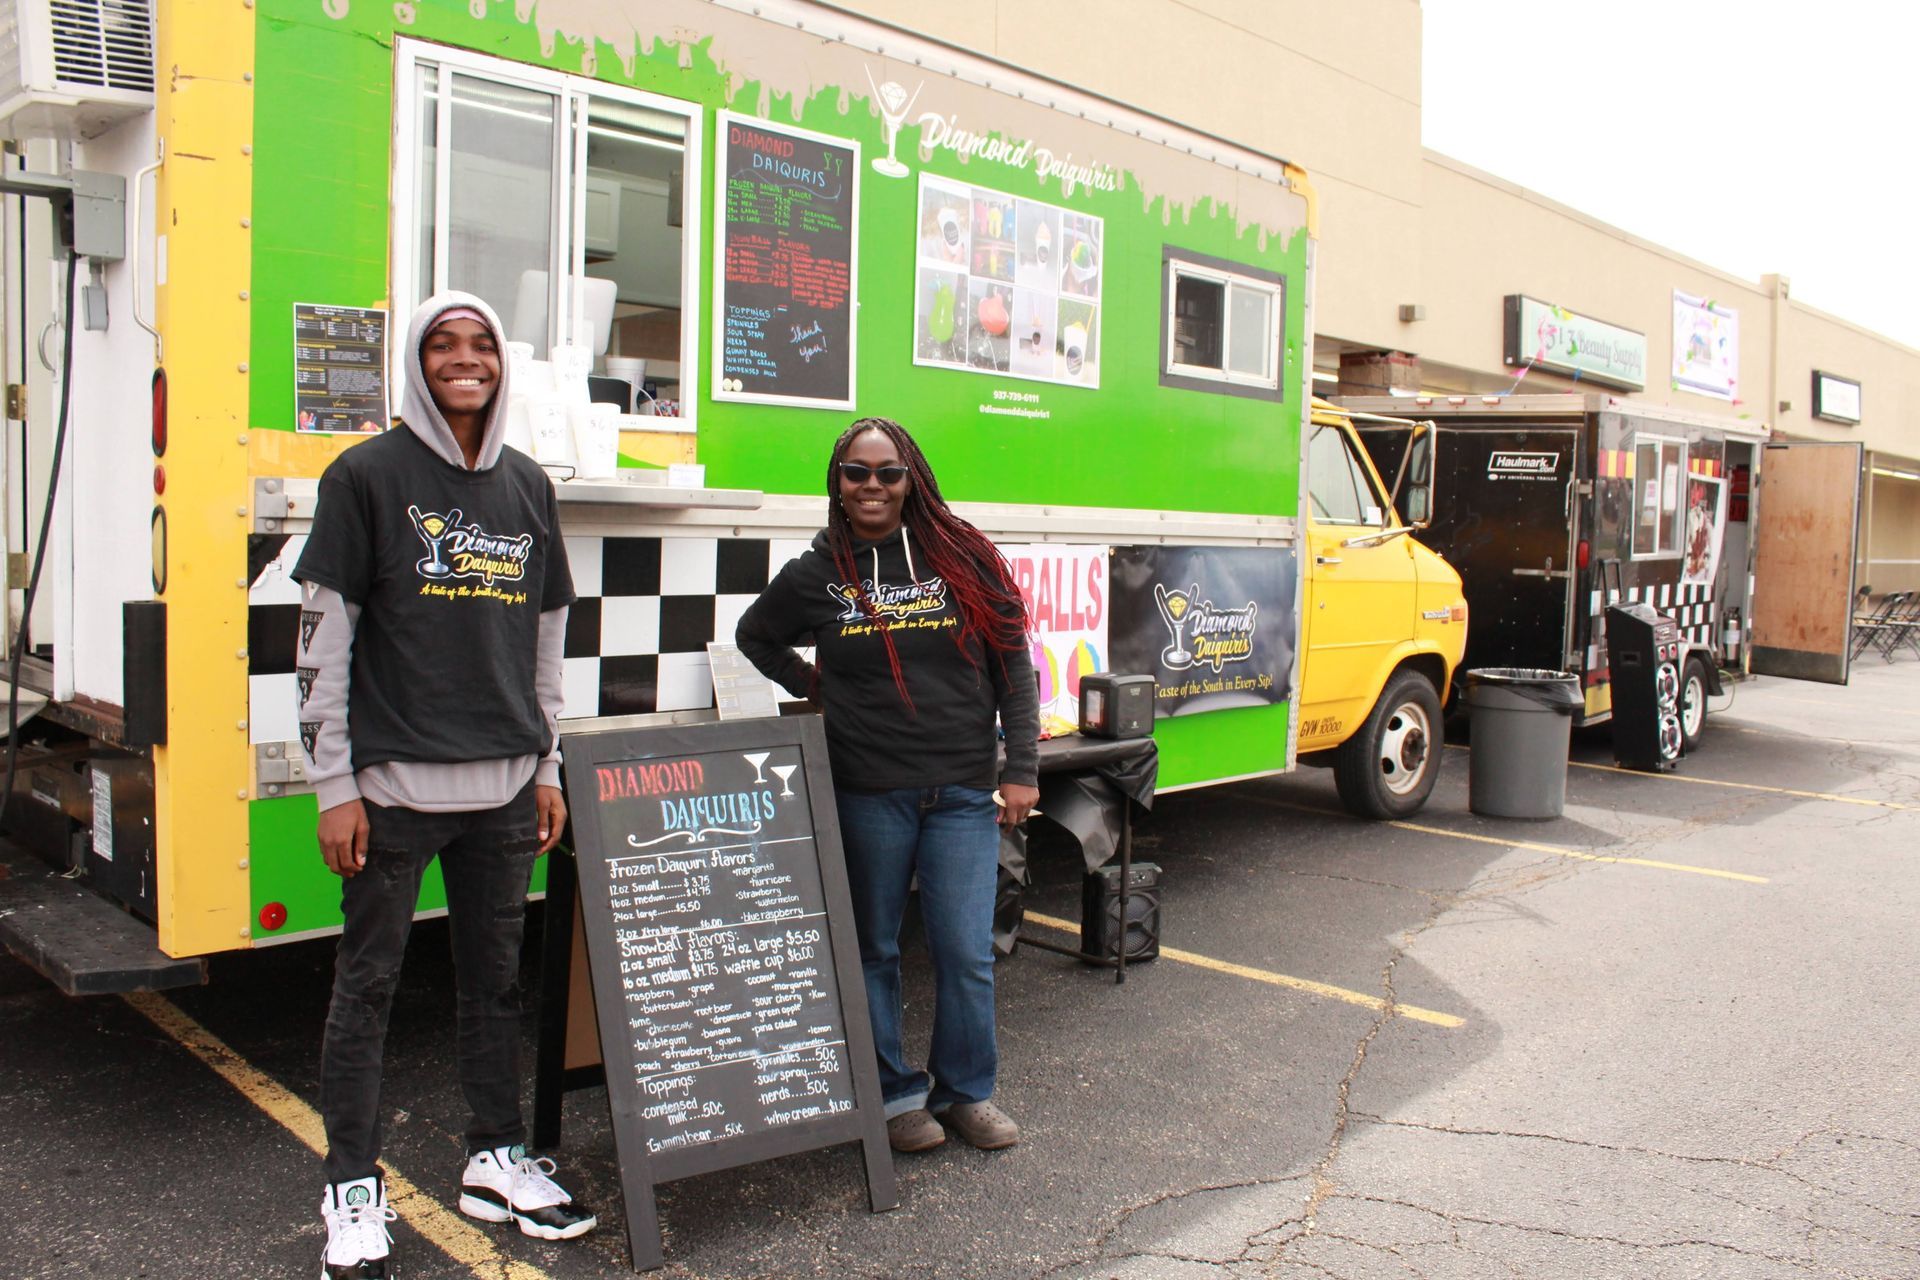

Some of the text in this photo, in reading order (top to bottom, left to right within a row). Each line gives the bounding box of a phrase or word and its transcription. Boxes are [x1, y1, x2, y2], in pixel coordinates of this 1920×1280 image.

[730, 128, 794, 158] DIAMOND
[918, 113, 1116, 196] Diamond Daiquiris
[753, 153, 826, 188] DAIQURIS
[727, 319, 759, 329] SPRINKLES
[729, 305, 771, 319] TOPPINGS
[726, 338, 747, 347] NERDS
[727, 328, 743, 337] SOUR
[790, 320, 823, 344] Thank
[1496, 456, 1548, 468] Haulmark
[445, 528, 529, 558] Diamond
[453, 552, 520, 580] Daiquiris
[419, 582, 430, 595] A
[447, 588, 457, 600] of
[457, 585, 471, 596] the
[870, 597, 941, 615] aiquiris
[1188, 607, 1254, 637] Diamond
[1194, 631, 1249, 666] Daiquiris
[1154, 684, 1179, 698] Taste
[1180, 680, 1190, 698] of
[1189, 679, 1201, 694] the
[1202, 678, 1224, 693] South
[1225, 678, 1233, 690] in
[1235, 675, 1256, 691] Every
[1258, 673, 1273, 690] Sip!
[596, 760, 703, 801] DIAMOND
[658, 856, 707, 875] Daiquiri
[711, 849, 756, 867] flavors
[735, 863, 775, 877] margarita
[751, 875, 792, 887] hurricane
[757, 894, 800, 906] watermelon
[621, 934, 683, 957] Snowball
[646, 952, 676, 969] small
[688, 948, 715, 962] $3.75
[754, 937, 784, 954] large
[786, 929, 820, 945] $5.50
[635, 976, 650, 987] oz
[724, 959, 760, 975] waffle
[764, 955, 784, 970] cup
[787, 946, 814, 962] $6.00
[747, 972, 776, 985] coconut
[629, 980, 813, 1004] raspberry grape margarita
[755, 996, 773, 1007] sour
[775, 993, 802, 1003] cherry
[631, 1017, 652, 1028] lime
[758, 1009, 780, 1022] green
[781, 1004, 801, 1016] apple
[643, 999, 732, 1017] butterscotch root beer
[703, 1027, 731, 1038] banana
[774, 1018, 798, 1029] colada
[718, 1036, 742, 1050] guava
[810, 1025, 832, 1034] lemon
[665, 1045, 713, 1059] strawberry
[710, 1052, 738, 1062] cotton
[815, 1047, 836, 1061] 50¢
[636, 1060, 701, 1073] peach cherry
[758, 1061, 839, 1085] sour spray 50¢
[637, 1075, 697, 1099] Toppings:
[761, 1079, 830, 1105] nerds 50¢
[643, 1097, 698, 1119] condensed
[667, 1111, 687, 1126] milk
[766, 1098, 852, 1125] whip cream $1.00
[649, 1135, 687, 1153] Gummy
[685, 1129, 712, 1143] bear
